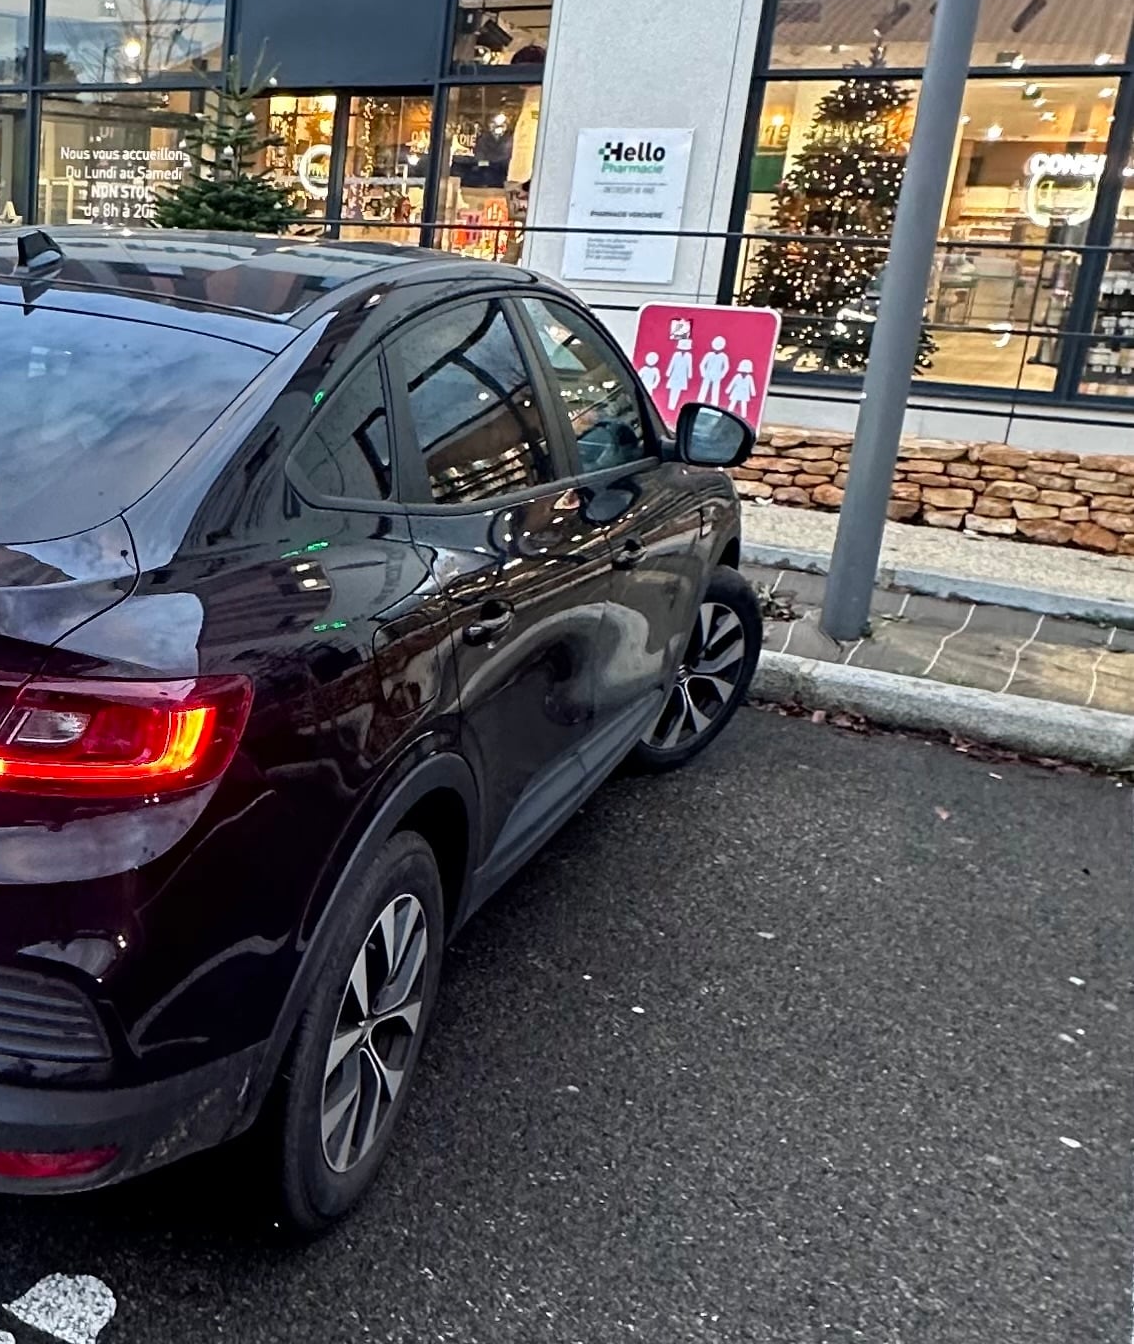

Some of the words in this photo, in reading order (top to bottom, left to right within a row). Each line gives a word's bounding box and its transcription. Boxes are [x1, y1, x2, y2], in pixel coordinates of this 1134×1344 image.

[60, 147, 91, 161] Nous
[92, 149, 122, 161] vous
[122, 149, 191, 162] accueillons
[599, 142, 666, 162] Hello
[65, 165, 82, 178] Du
[84, 165, 117, 179] Lundi
[119, 167, 135, 180] au
[137, 165, 183, 180] Samedi
[601, 163, 664, 174] Pharmacie
[91, 184, 118, 199] NON
[84, 203, 100, 218] de
[103, 203, 119, 217] 8h
[122, 203, 131, 218] à
